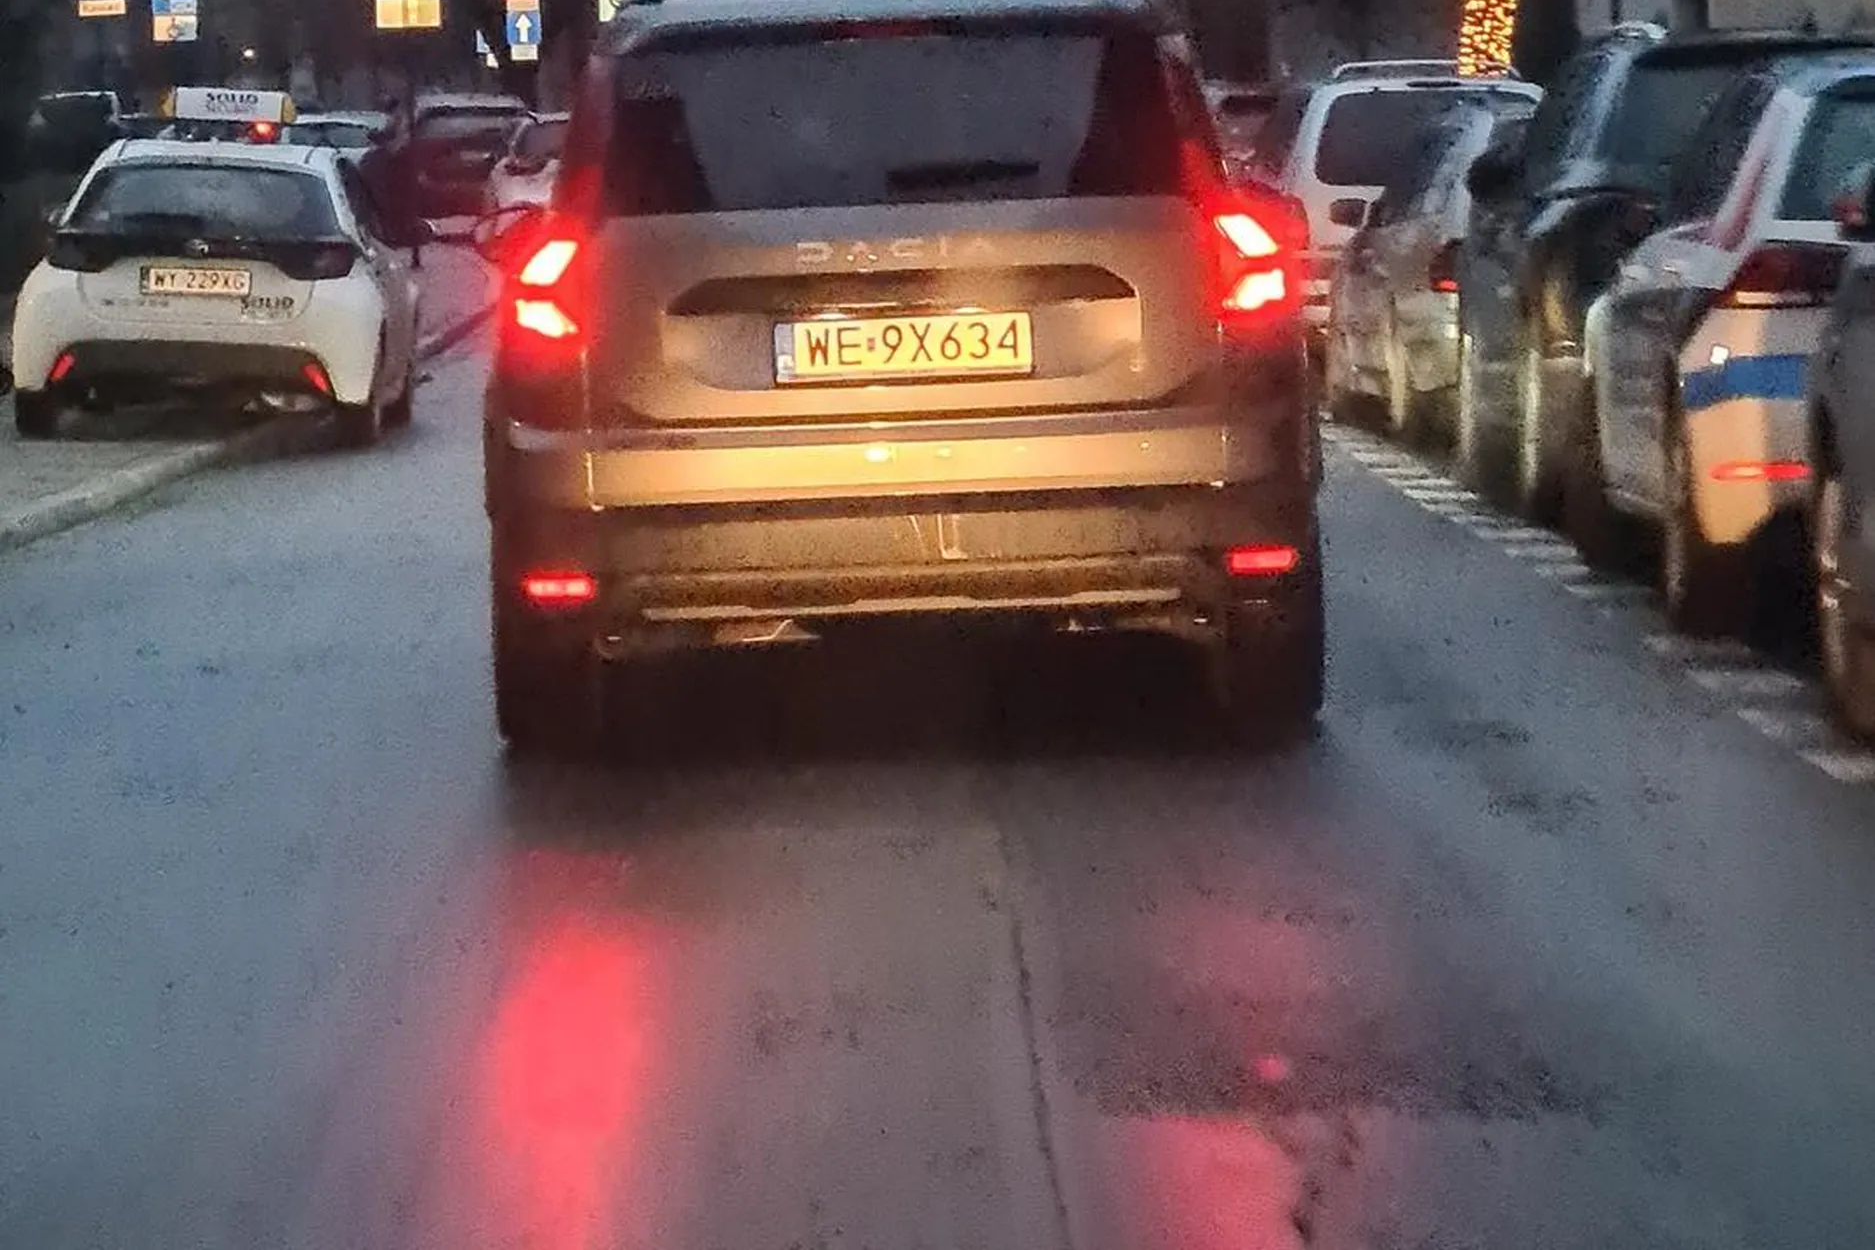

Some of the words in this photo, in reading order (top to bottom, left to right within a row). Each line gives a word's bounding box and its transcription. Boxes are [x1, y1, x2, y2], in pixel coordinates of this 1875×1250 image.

[796, 235, 996, 264] DACIA
[805, 325, 862, 367] WE
[881, 318, 1020, 365] 9X634
